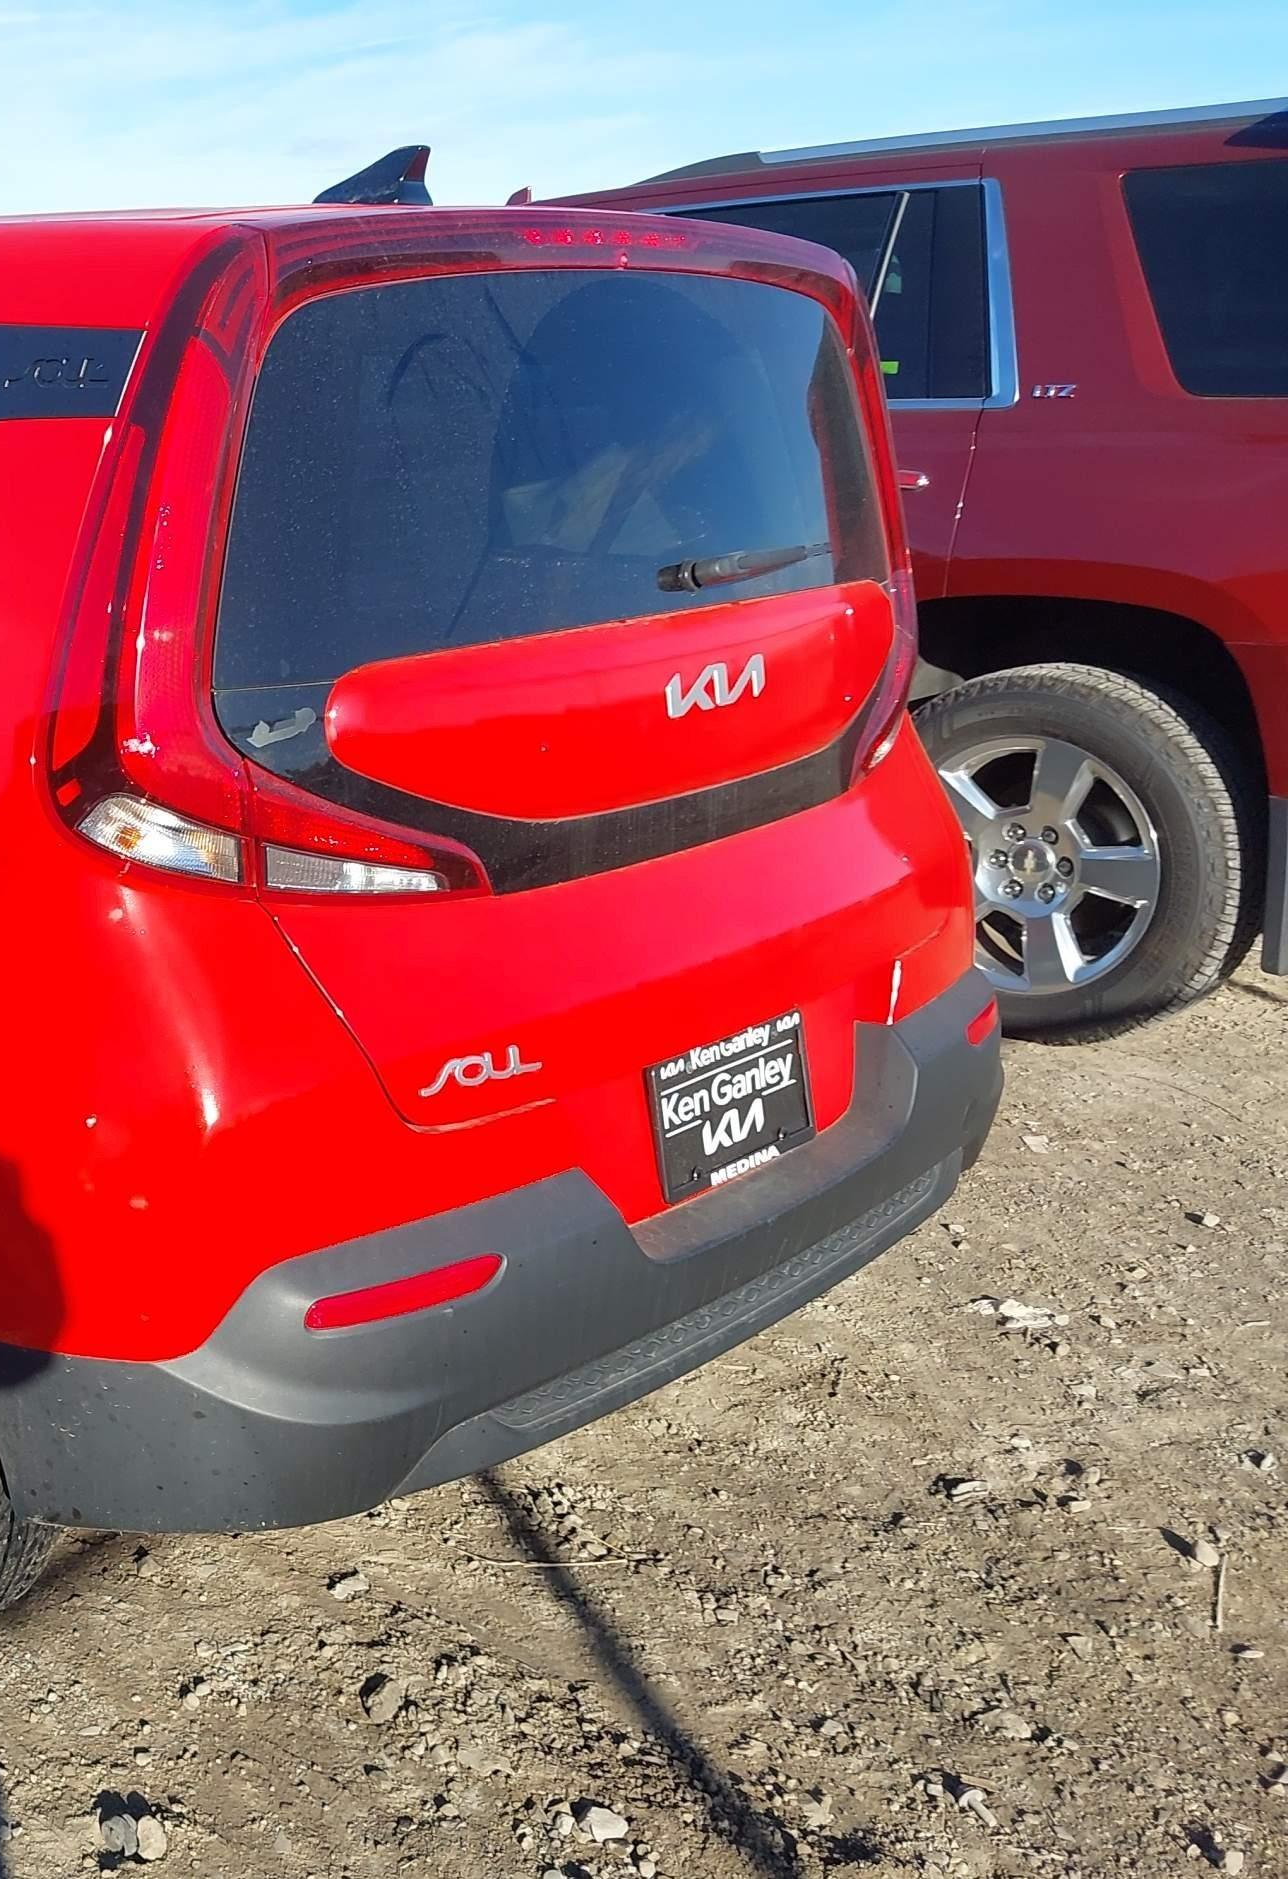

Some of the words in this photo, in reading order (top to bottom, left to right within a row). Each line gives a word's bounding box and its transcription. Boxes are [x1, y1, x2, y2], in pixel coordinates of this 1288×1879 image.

[665, 653, 765, 719] KIA
[418, 1044, 543, 1097] SOUL
[689, 1046, 720, 1070] Ken
[720, 1022, 772, 1056] Ganley
[660, 1088, 710, 1130] Ken
[711, 1053, 794, 1106] Ganley
[702, 1097, 765, 1156] KIA
[710, 1144, 781, 1186] MEDINA
